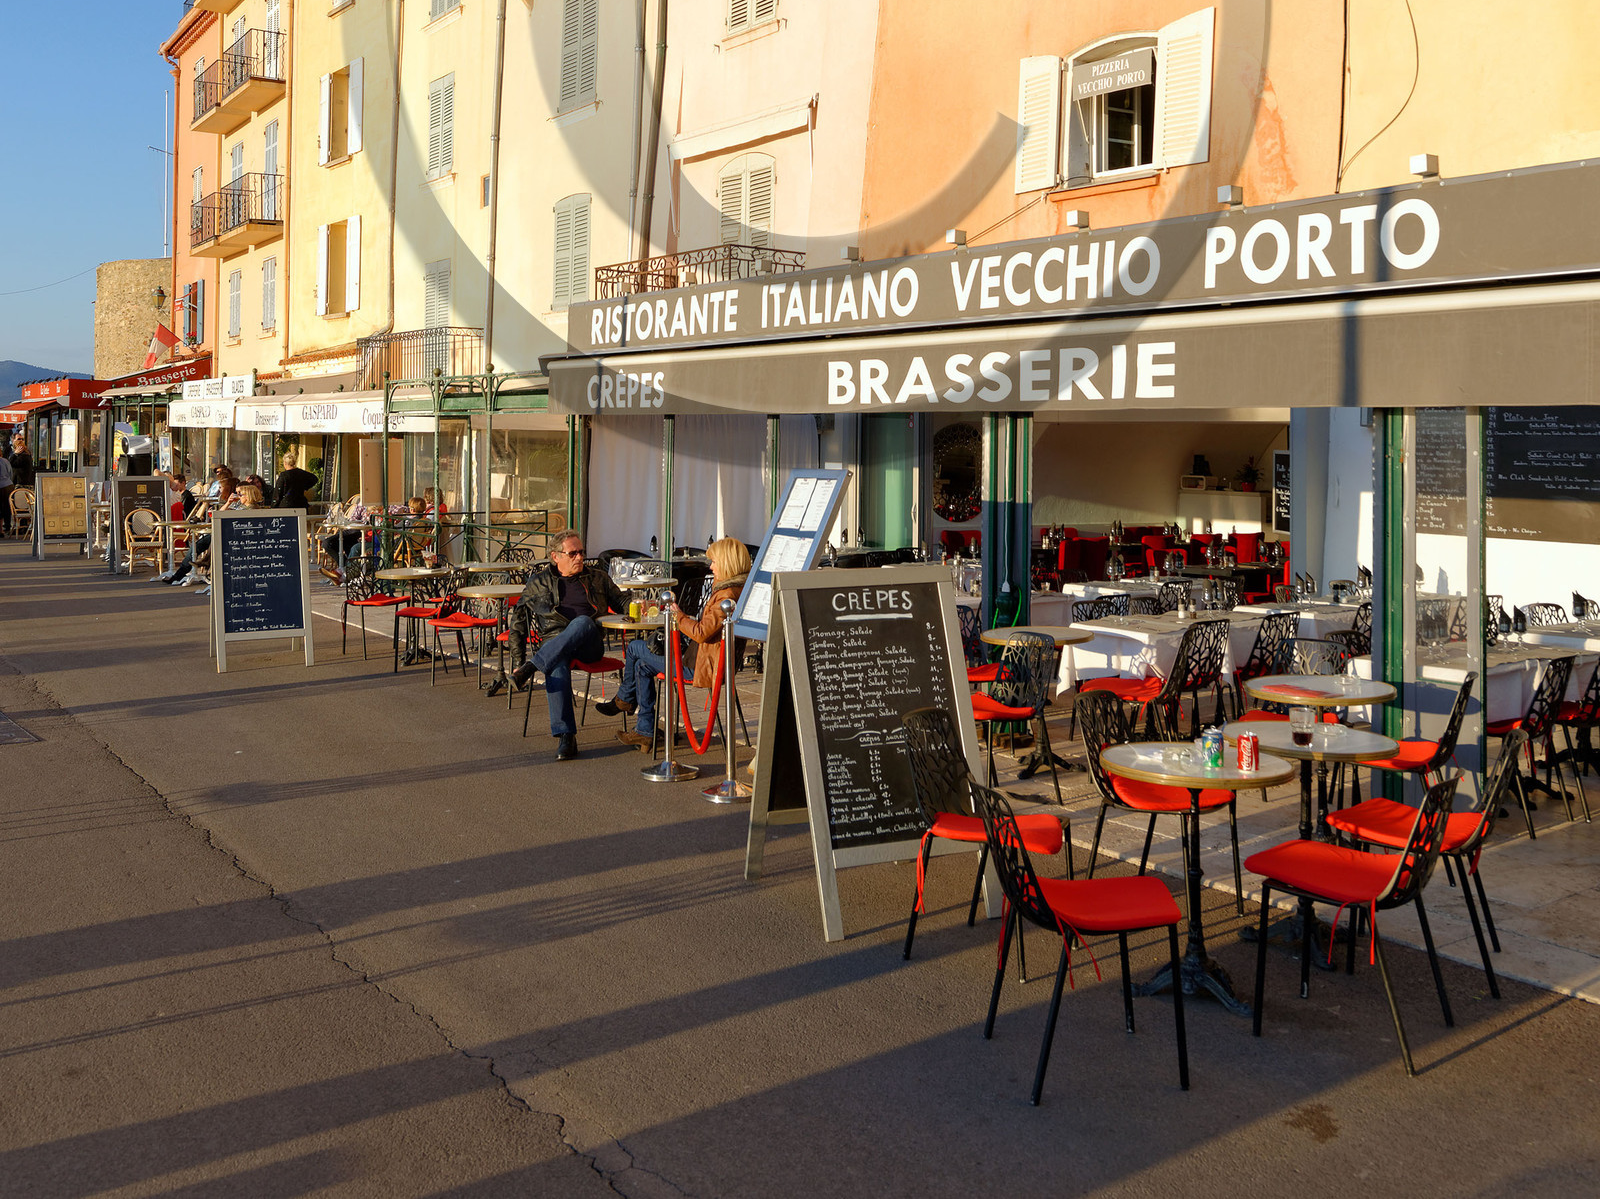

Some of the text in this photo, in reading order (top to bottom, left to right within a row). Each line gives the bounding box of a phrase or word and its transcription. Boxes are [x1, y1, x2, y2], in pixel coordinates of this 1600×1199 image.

[1092, 59, 1130, 77] PIZZERIA
[1078, 69, 1146, 95] VECCHIO PORTO
[590, 198, 1440, 345] RISTORANTE ITALIANO VECCHIO PORTO
[137, 366, 197, 389] Brasserie
[587, 341, 1176, 409] CRÊPES BRASSERIE
[82, 391, 99, 399] BAR
[255, 410, 280, 426] Brasserie
[302, 404, 338, 421] GASPARD
[850, 626, 873, 637] Salade
[843, 638, 867, 648] Salade
[884, 645, 908, 655] Salade
[867, 667, 889, 677] Salade
[868, 678, 887, 687] Salade
[878, 708, 898, 718] Salade
